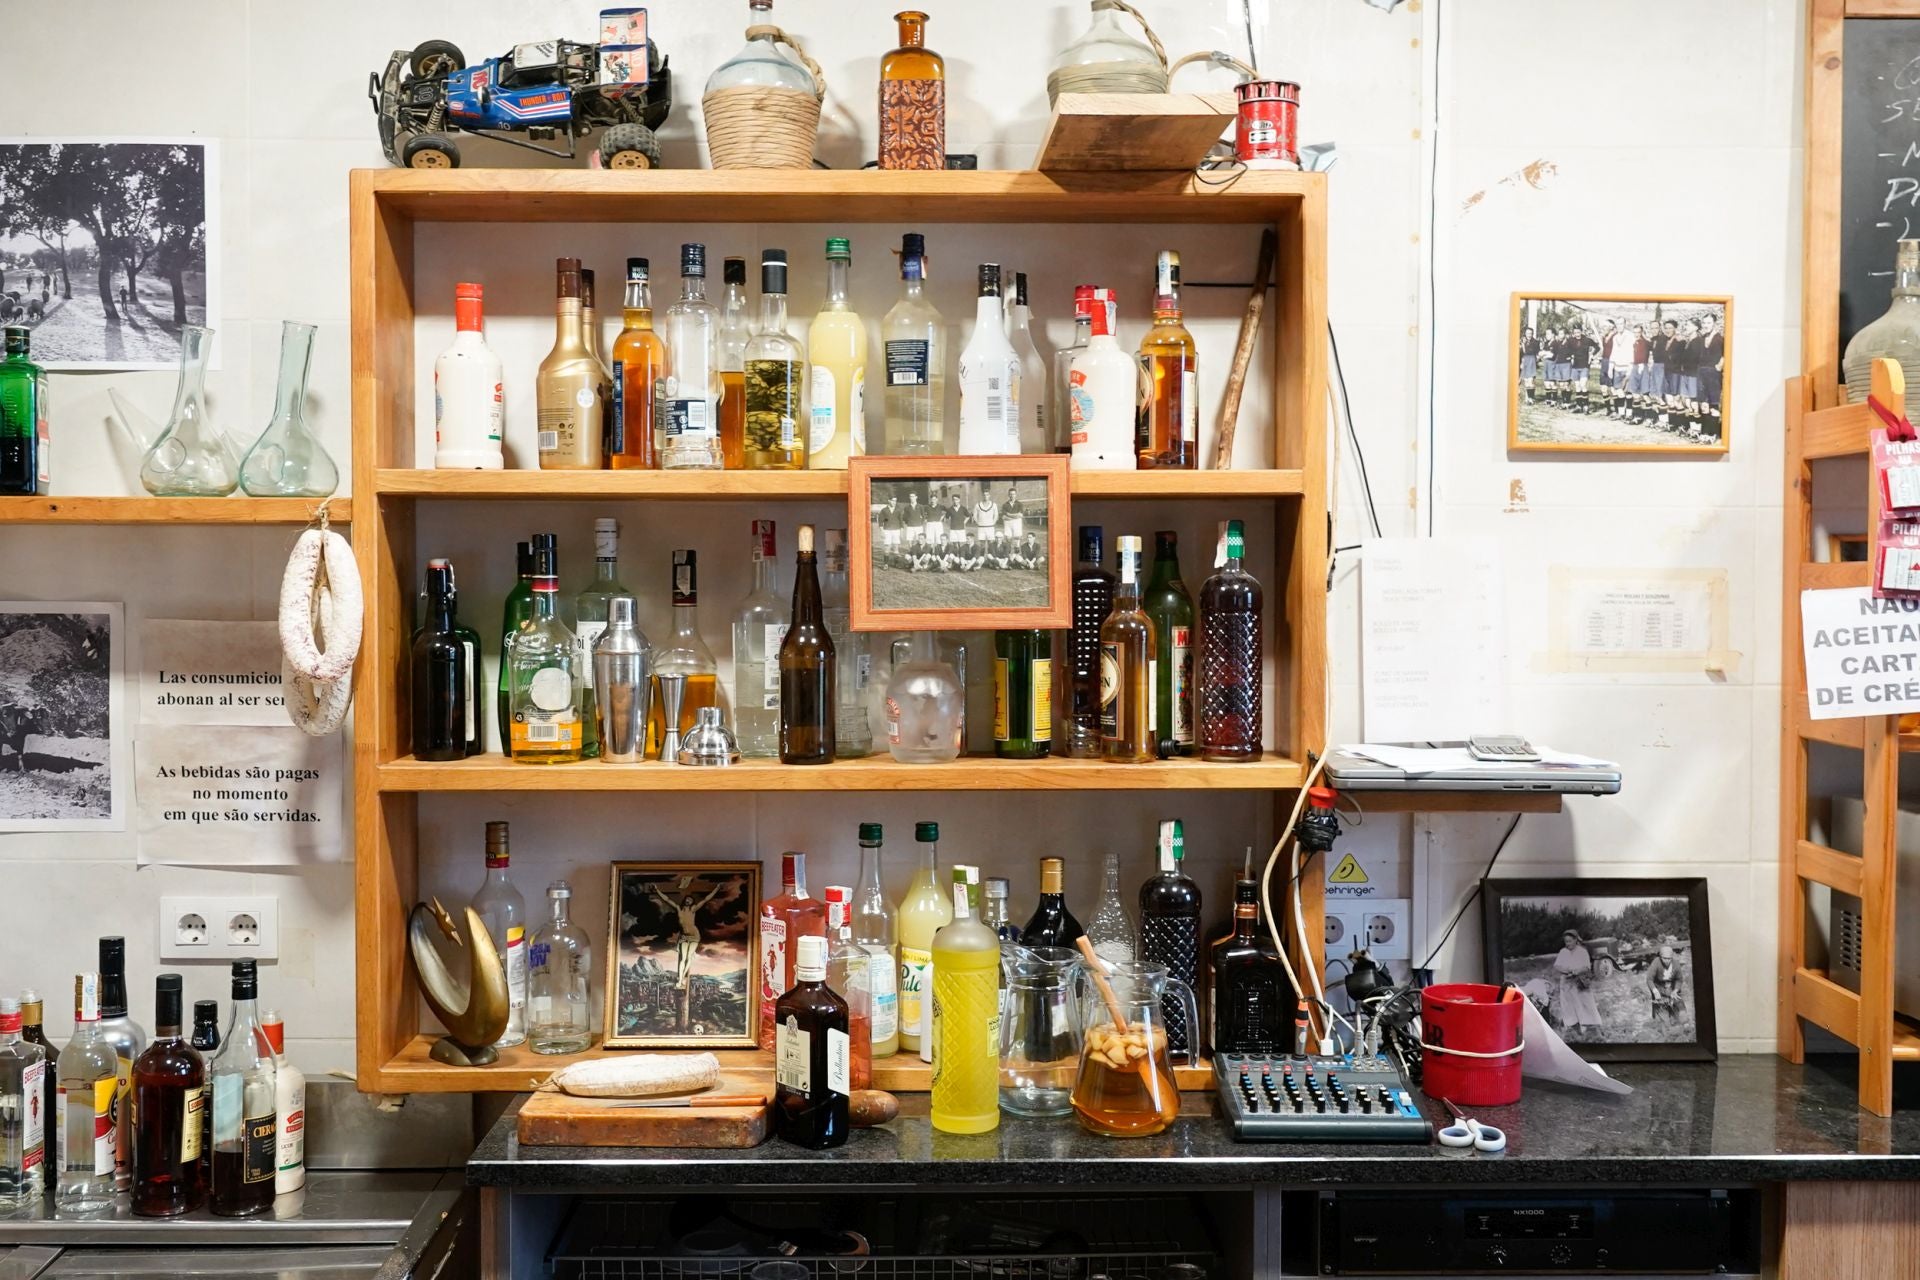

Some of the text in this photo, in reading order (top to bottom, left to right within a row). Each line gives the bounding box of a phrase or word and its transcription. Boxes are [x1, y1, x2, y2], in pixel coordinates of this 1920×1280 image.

[1813, 623, 1920, 648] ACEITA
[159, 670, 187, 684] Las
[157, 691, 213, 706] abonan
[219, 693, 233, 705] al
[238, 696, 261, 705] ser
[1816, 686, 1854, 706] DE
[156, 766, 320, 783] As bebidas são pagas
[193, 788, 288, 800] no momento
[164, 808, 321, 824] em que são servidas.
[761, 920, 785, 935] BEEFEATER
[1513, 1209, 1545, 1217] NX1000
